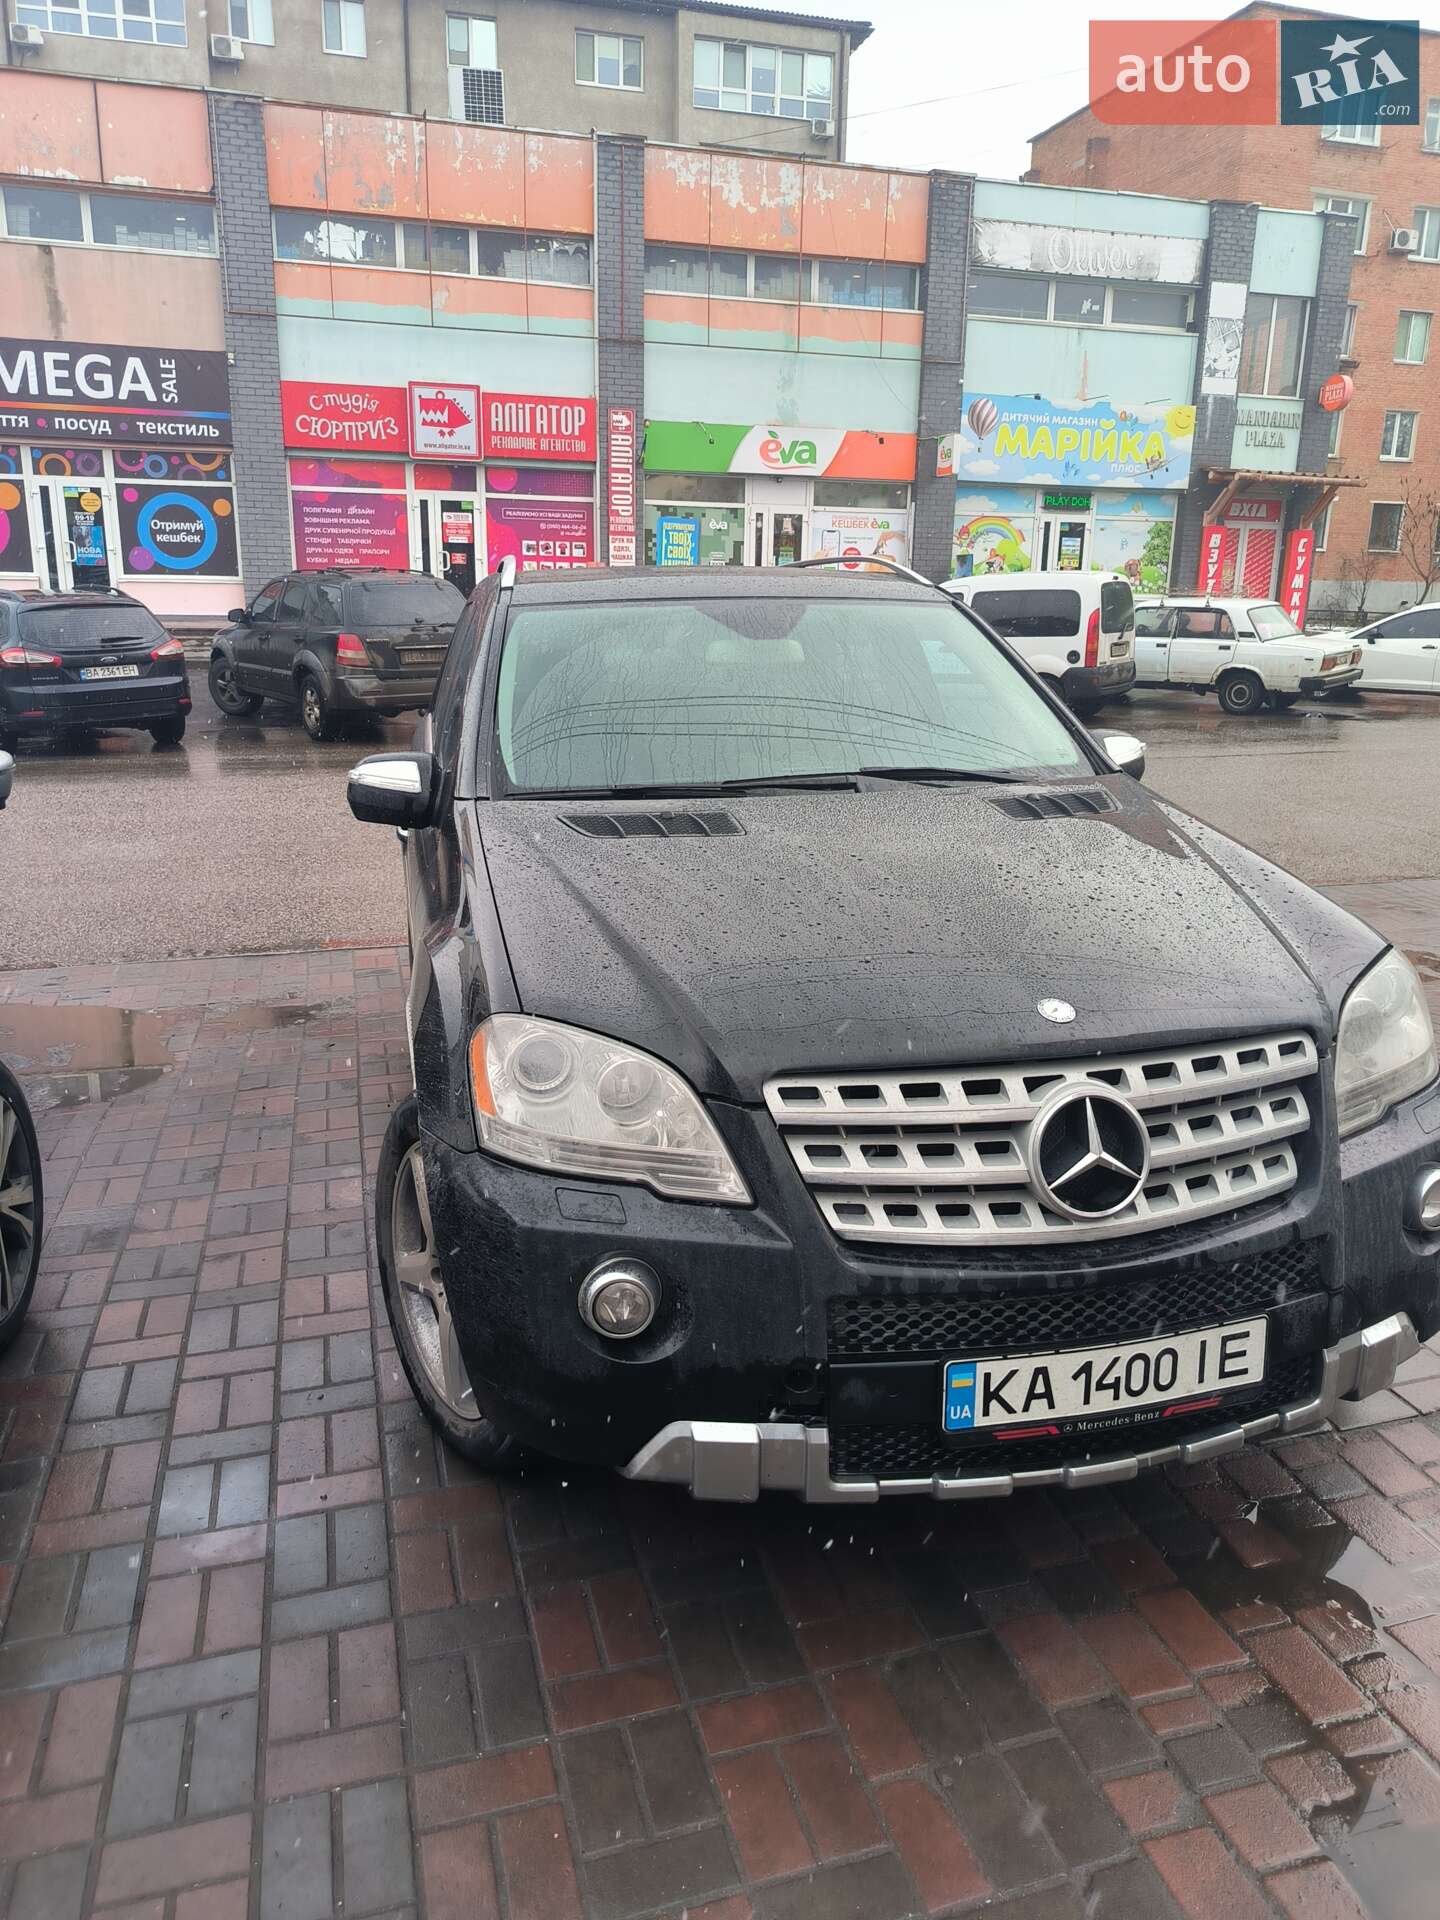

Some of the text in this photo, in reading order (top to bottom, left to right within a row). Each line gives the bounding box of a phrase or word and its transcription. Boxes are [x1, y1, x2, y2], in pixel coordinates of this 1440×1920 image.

[160, 358, 178, 404] SALE
[309, 393, 379, 414] Студія
[54, 416, 112, 435] посуд
[136, 421, 220, 437] текстиль
[1001, 412, 1099, 426] ДИТЯЧИЙ МАГАЗИН
[296, 414, 399, 440] СЮРПРИЗ
[540, 438, 586, 453] АГЕНТСТВО
[994, 418, 1167, 464] МАРІЙКА
[151, 519, 204, 533] Отримуй
[339, 517, 371, 525] РЕКЛАМА
[831, 519, 870, 529] КЕШБЕК
[156, 532, 201, 543] кешбек
[981, 1330, 1250, 1417] KA 1400 IE
[951, 1405, 972, 1420] UA
